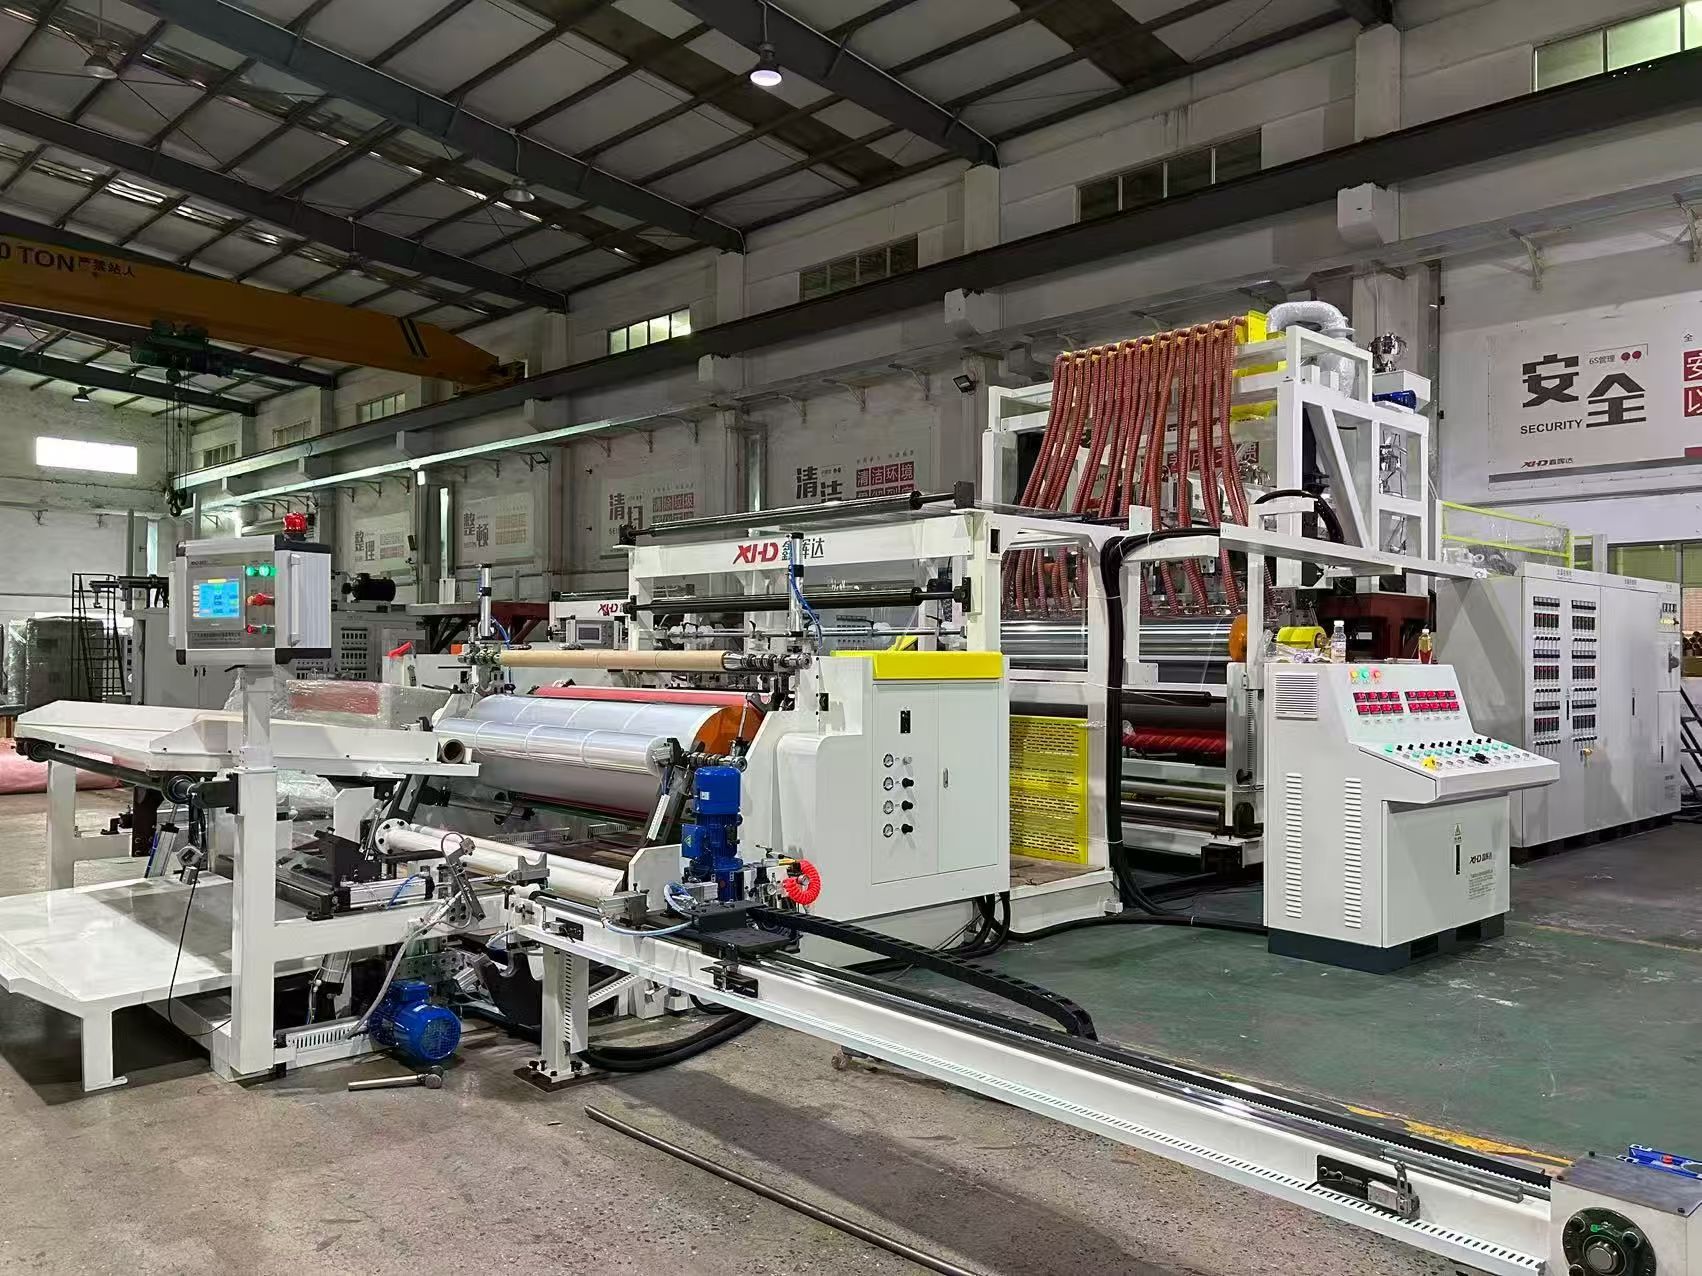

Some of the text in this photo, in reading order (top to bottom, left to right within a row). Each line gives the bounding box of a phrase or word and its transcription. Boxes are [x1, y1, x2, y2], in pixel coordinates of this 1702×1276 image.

[18, 246, 74, 272] TON
[1522, 353, 1647, 429] 安全
[1520, 419, 1583, 435] SECURITY
[856, 462, 914, 488] 清洁环境
[463, 512, 489, 547] 整顿
[732, 542, 779, 565] XHD
